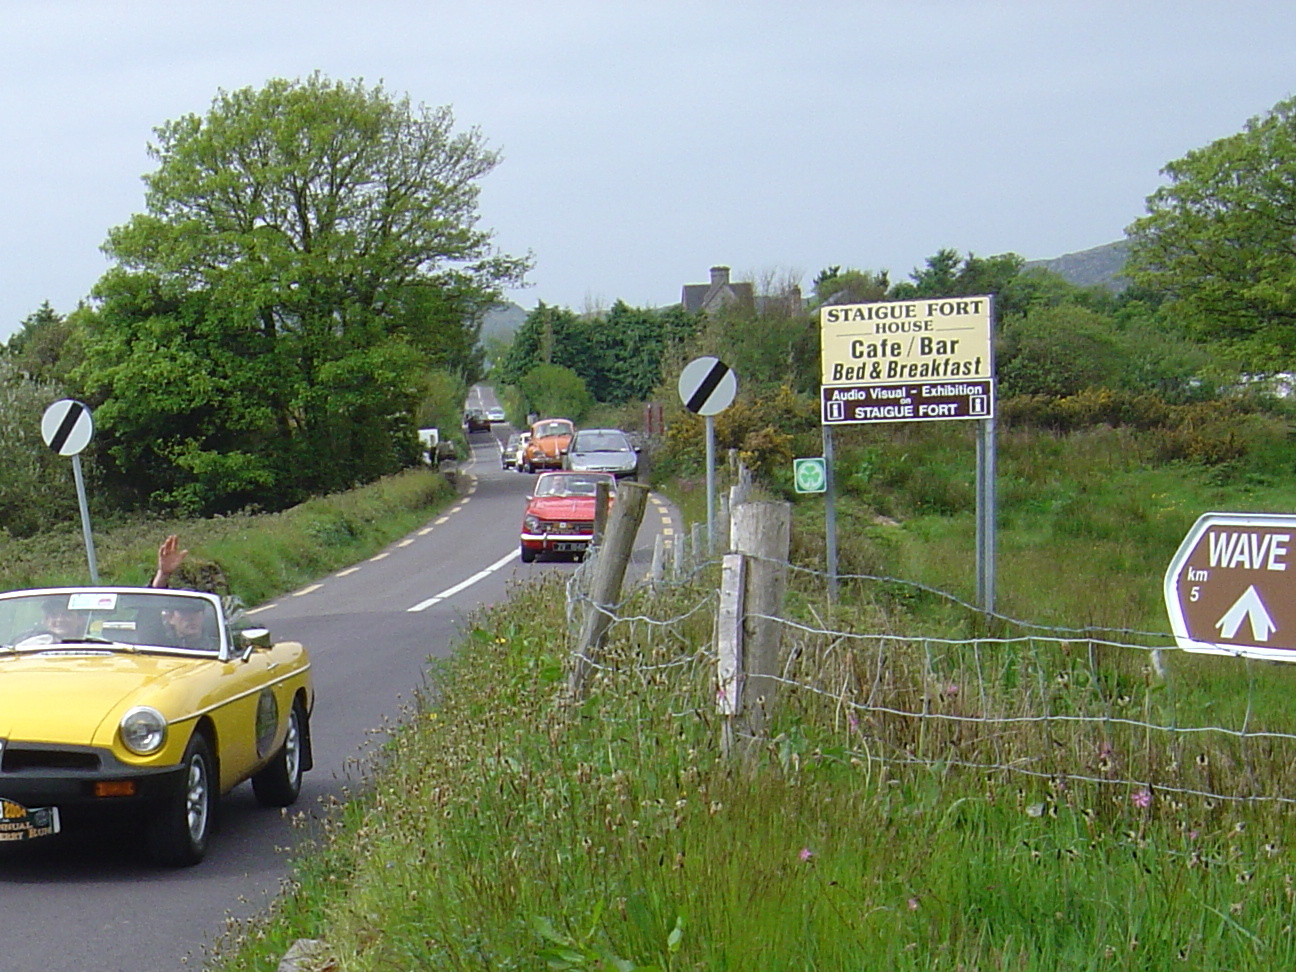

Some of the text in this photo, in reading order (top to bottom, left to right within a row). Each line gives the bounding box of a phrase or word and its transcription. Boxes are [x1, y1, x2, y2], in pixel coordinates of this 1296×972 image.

[827, 300, 983, 323] STAIGUE FORT
[874, 320, 934, 334] HOUSE
[832, 362, 867, 381] Bed
[886, 356, 982, 379] Breakfast
[832, 389, 866, 401] Audio
[870, 386, 906, 399] Visual
[922, 384, 983, 398] Exhibition
[900, 397, 911, 405] on
[855, 403, 958, 419] STAIGUE FORT
[1209, 531, 1291, 571] WAVE
[1187, 567, 1208, 582] km
[1190, 586, 1200, 602] 5
